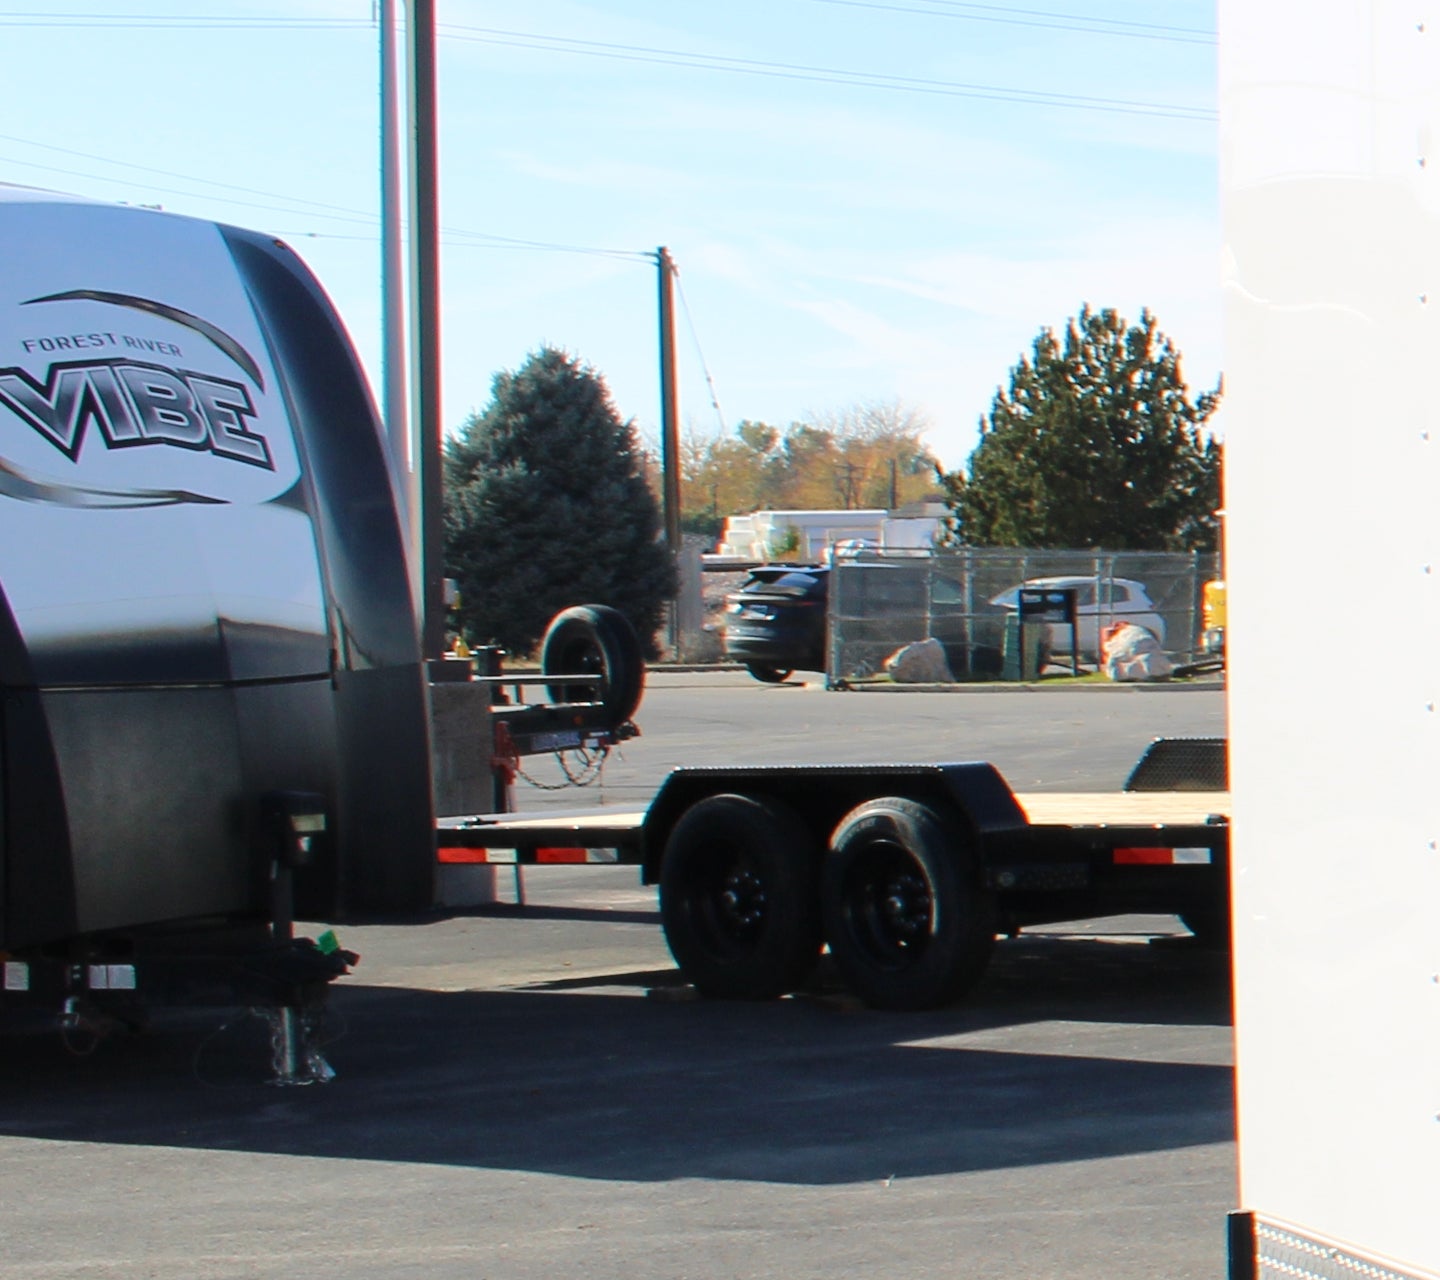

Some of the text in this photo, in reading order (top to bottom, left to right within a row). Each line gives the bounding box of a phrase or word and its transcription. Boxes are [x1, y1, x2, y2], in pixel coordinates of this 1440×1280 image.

[22, 332, 183, 357] FOREST RIVER
[0, 358, 277, 472] VIBE
